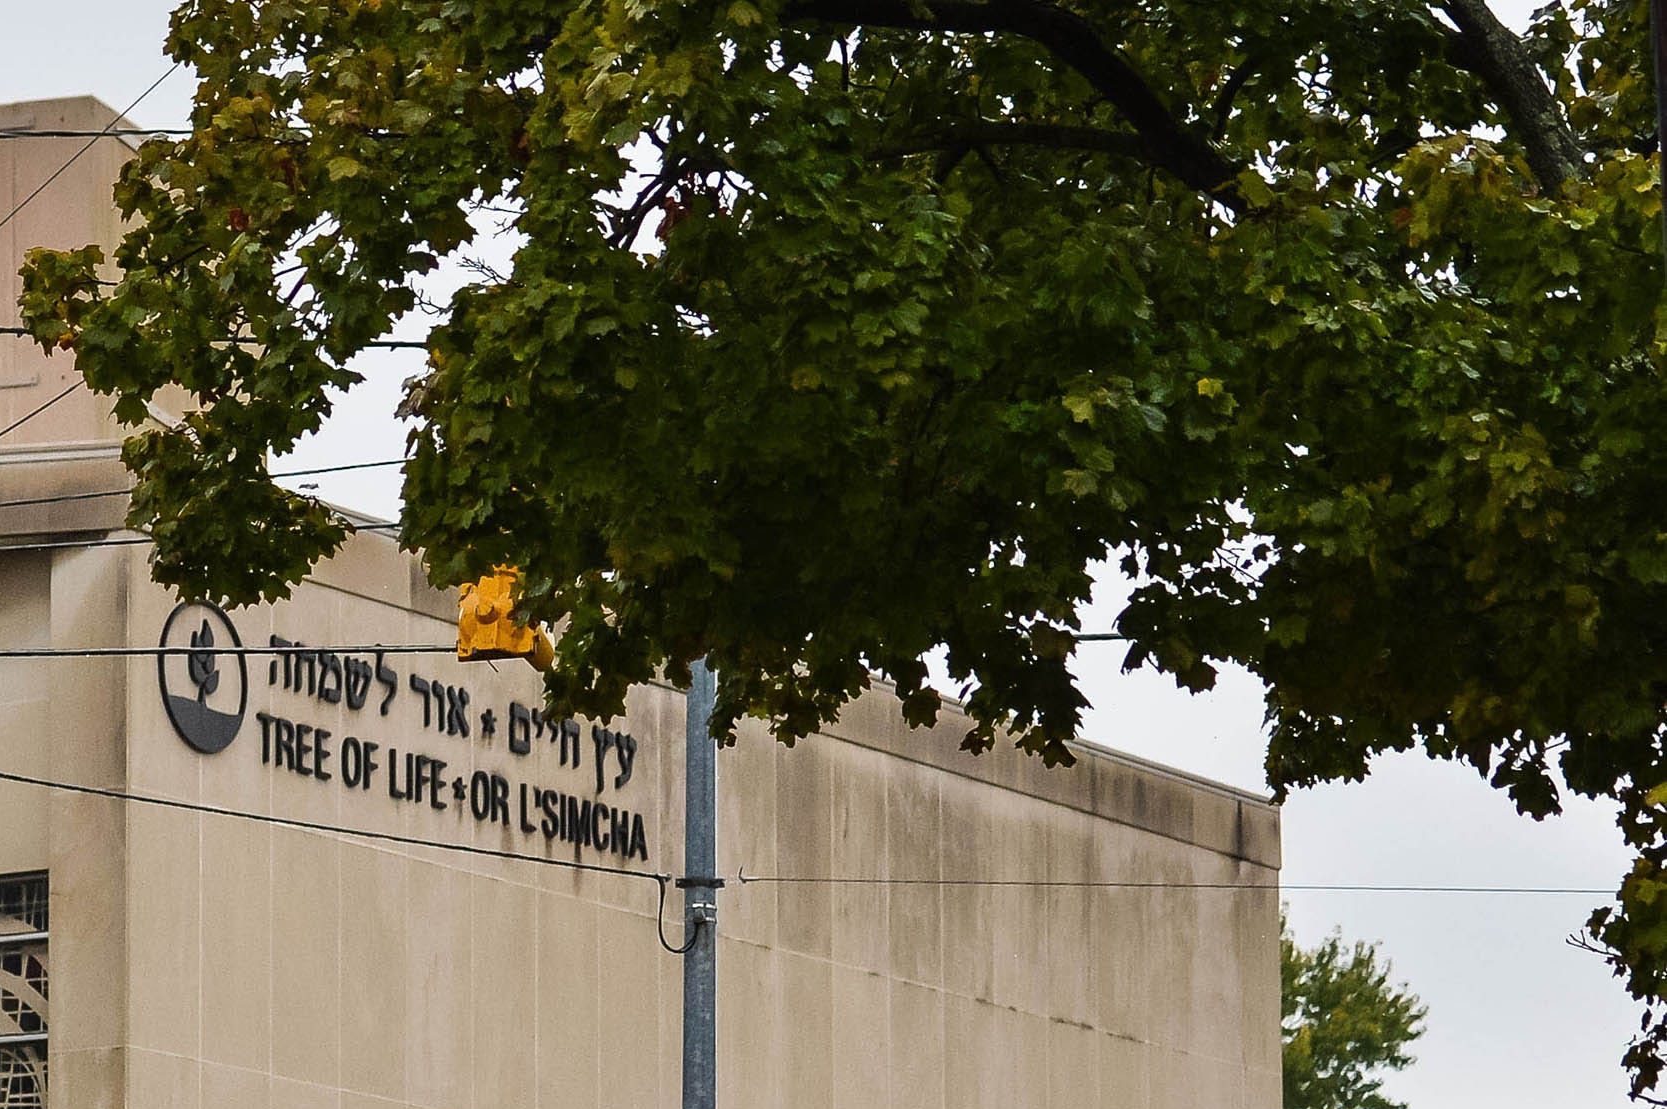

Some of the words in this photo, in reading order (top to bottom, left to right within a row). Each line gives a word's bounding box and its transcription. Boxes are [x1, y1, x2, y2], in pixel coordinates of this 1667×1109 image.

[268, 633, 399, 717] לשמחה
[409, 672, 471, 739] אור
[255, 711, 333, 782] TREE
[340, 736, 380, 790] OF
[389, 748, 448, 810] LIFE
[470, 770, 510, 826] OR
[519, 783, 649, 862] L'SIMCHA
[591, 724, 639, 795] עץ
